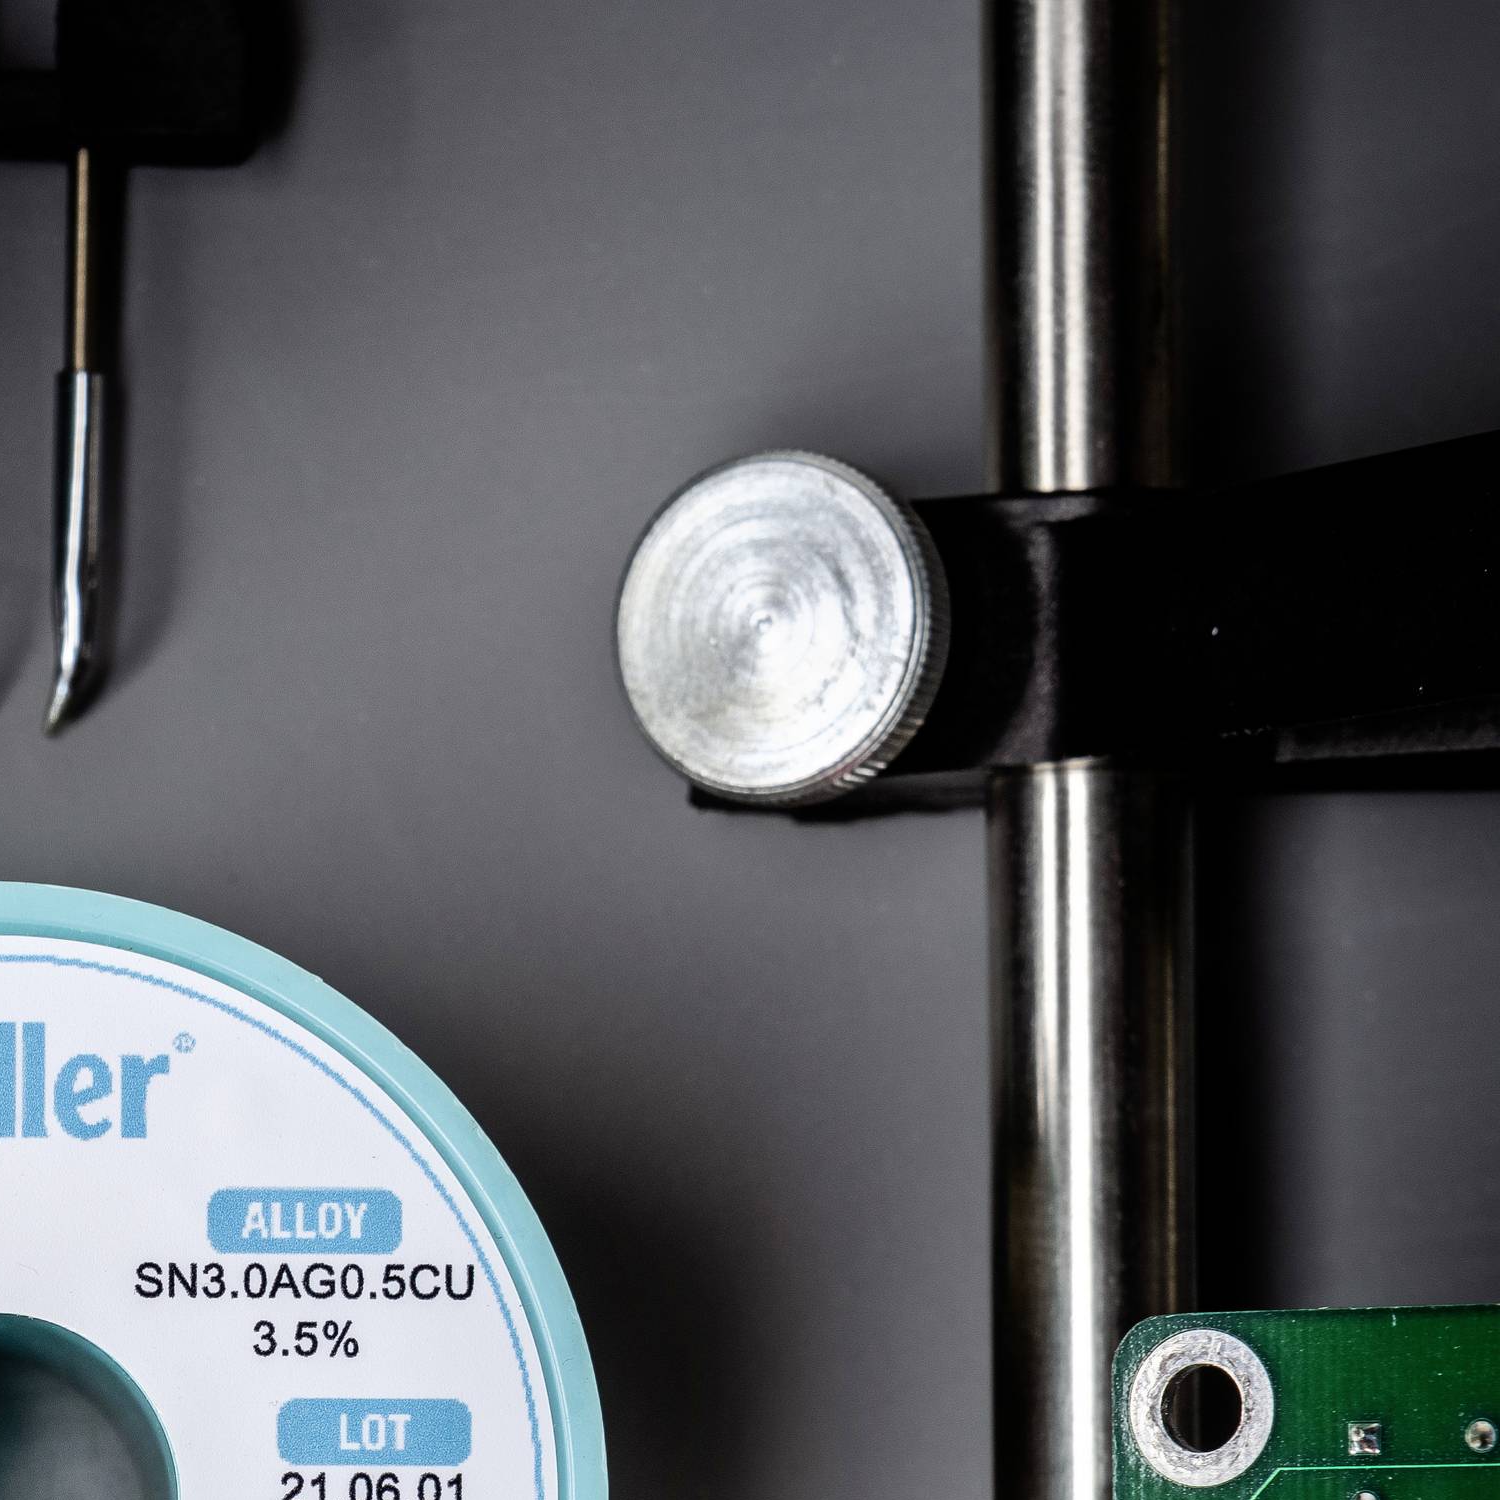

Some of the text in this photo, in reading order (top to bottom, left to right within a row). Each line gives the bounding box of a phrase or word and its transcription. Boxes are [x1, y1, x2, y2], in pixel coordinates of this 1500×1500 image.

[242, 1201, 367, 1239] ALLOY
[135, 1261, 475, 1301] SN3.0AG0.5CU
[253, 1320, 359, 1358] 3.5%
[339, 1413, 412, 1451] LOT
